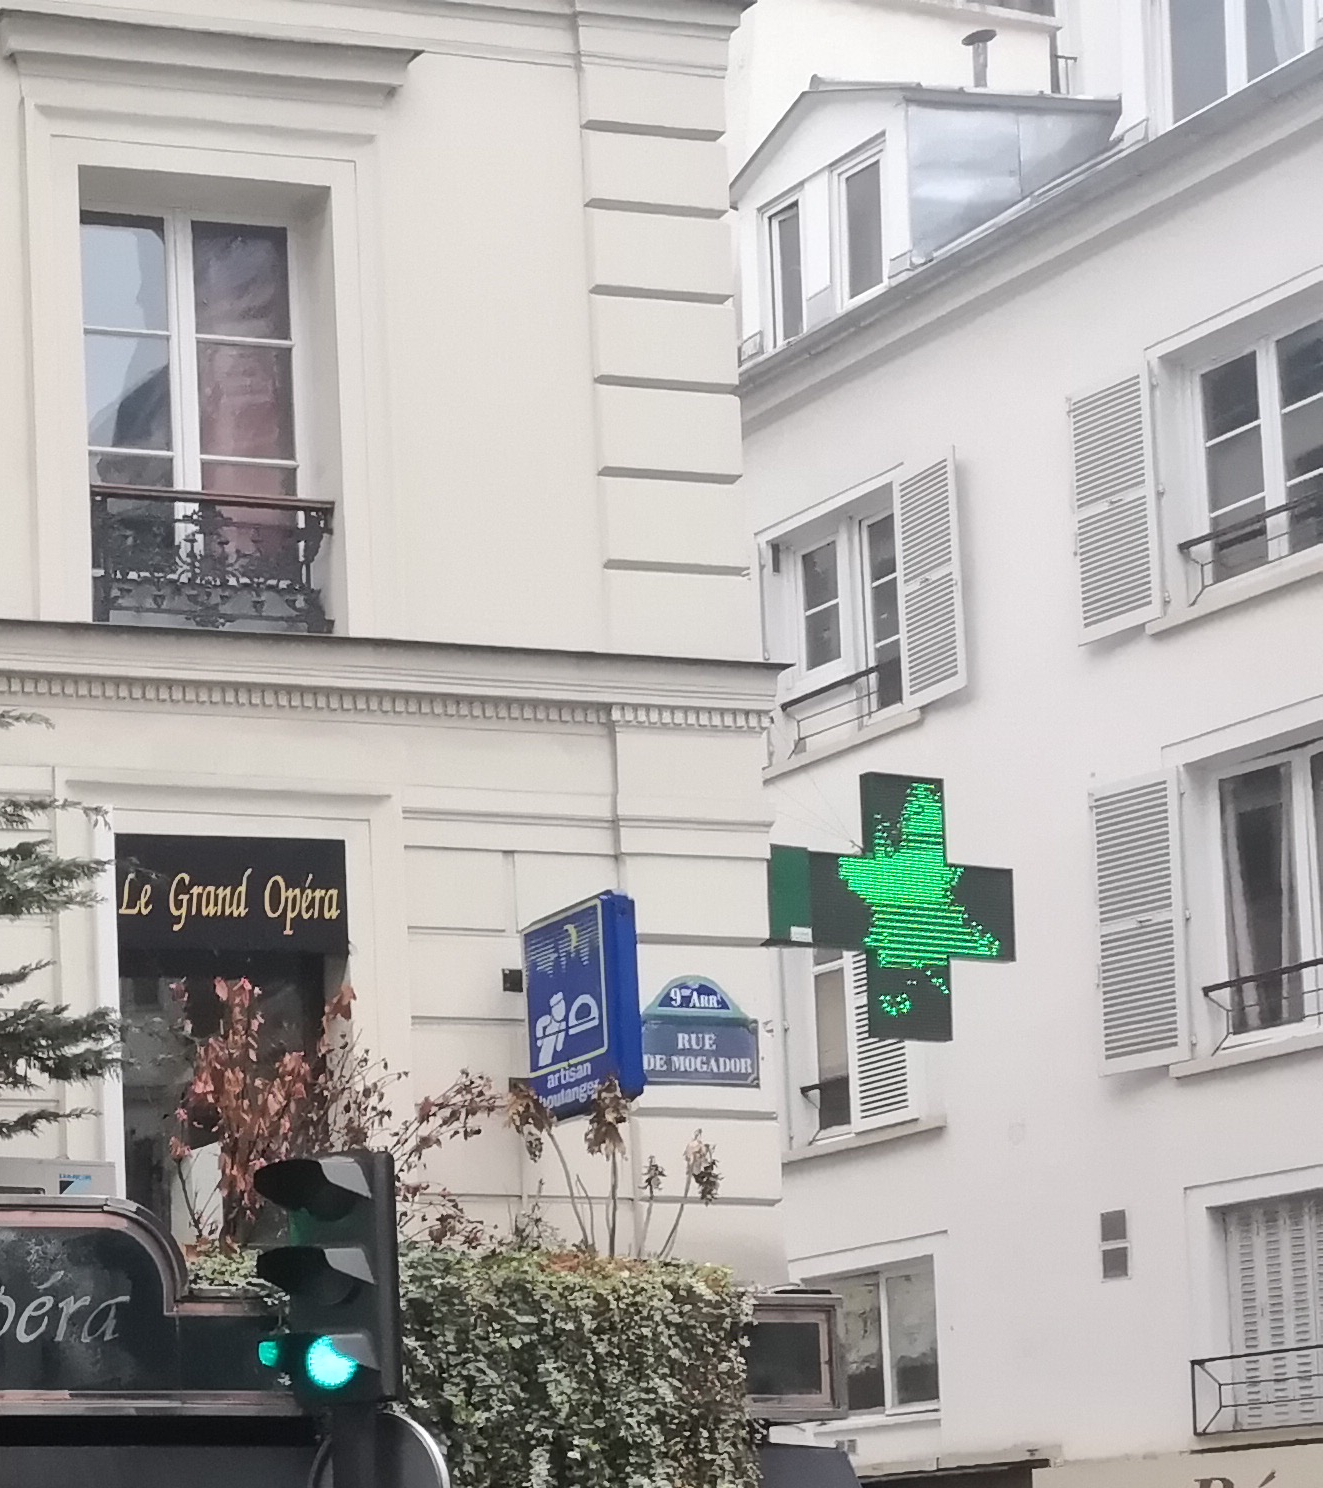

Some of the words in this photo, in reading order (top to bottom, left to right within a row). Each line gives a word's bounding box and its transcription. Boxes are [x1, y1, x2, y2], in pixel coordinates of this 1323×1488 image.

[119, 872, 153, 915] Le
[168, 867, 253, 931] Grand
[263, 873, 341, 935] Opéra
[676, 1033, 717, 1050] RUE
[644, 1055, 666, 1072] DE
[670, 1056, 753, 1073] MOGADOR
[547, 1062, 591, 1089] artisan
